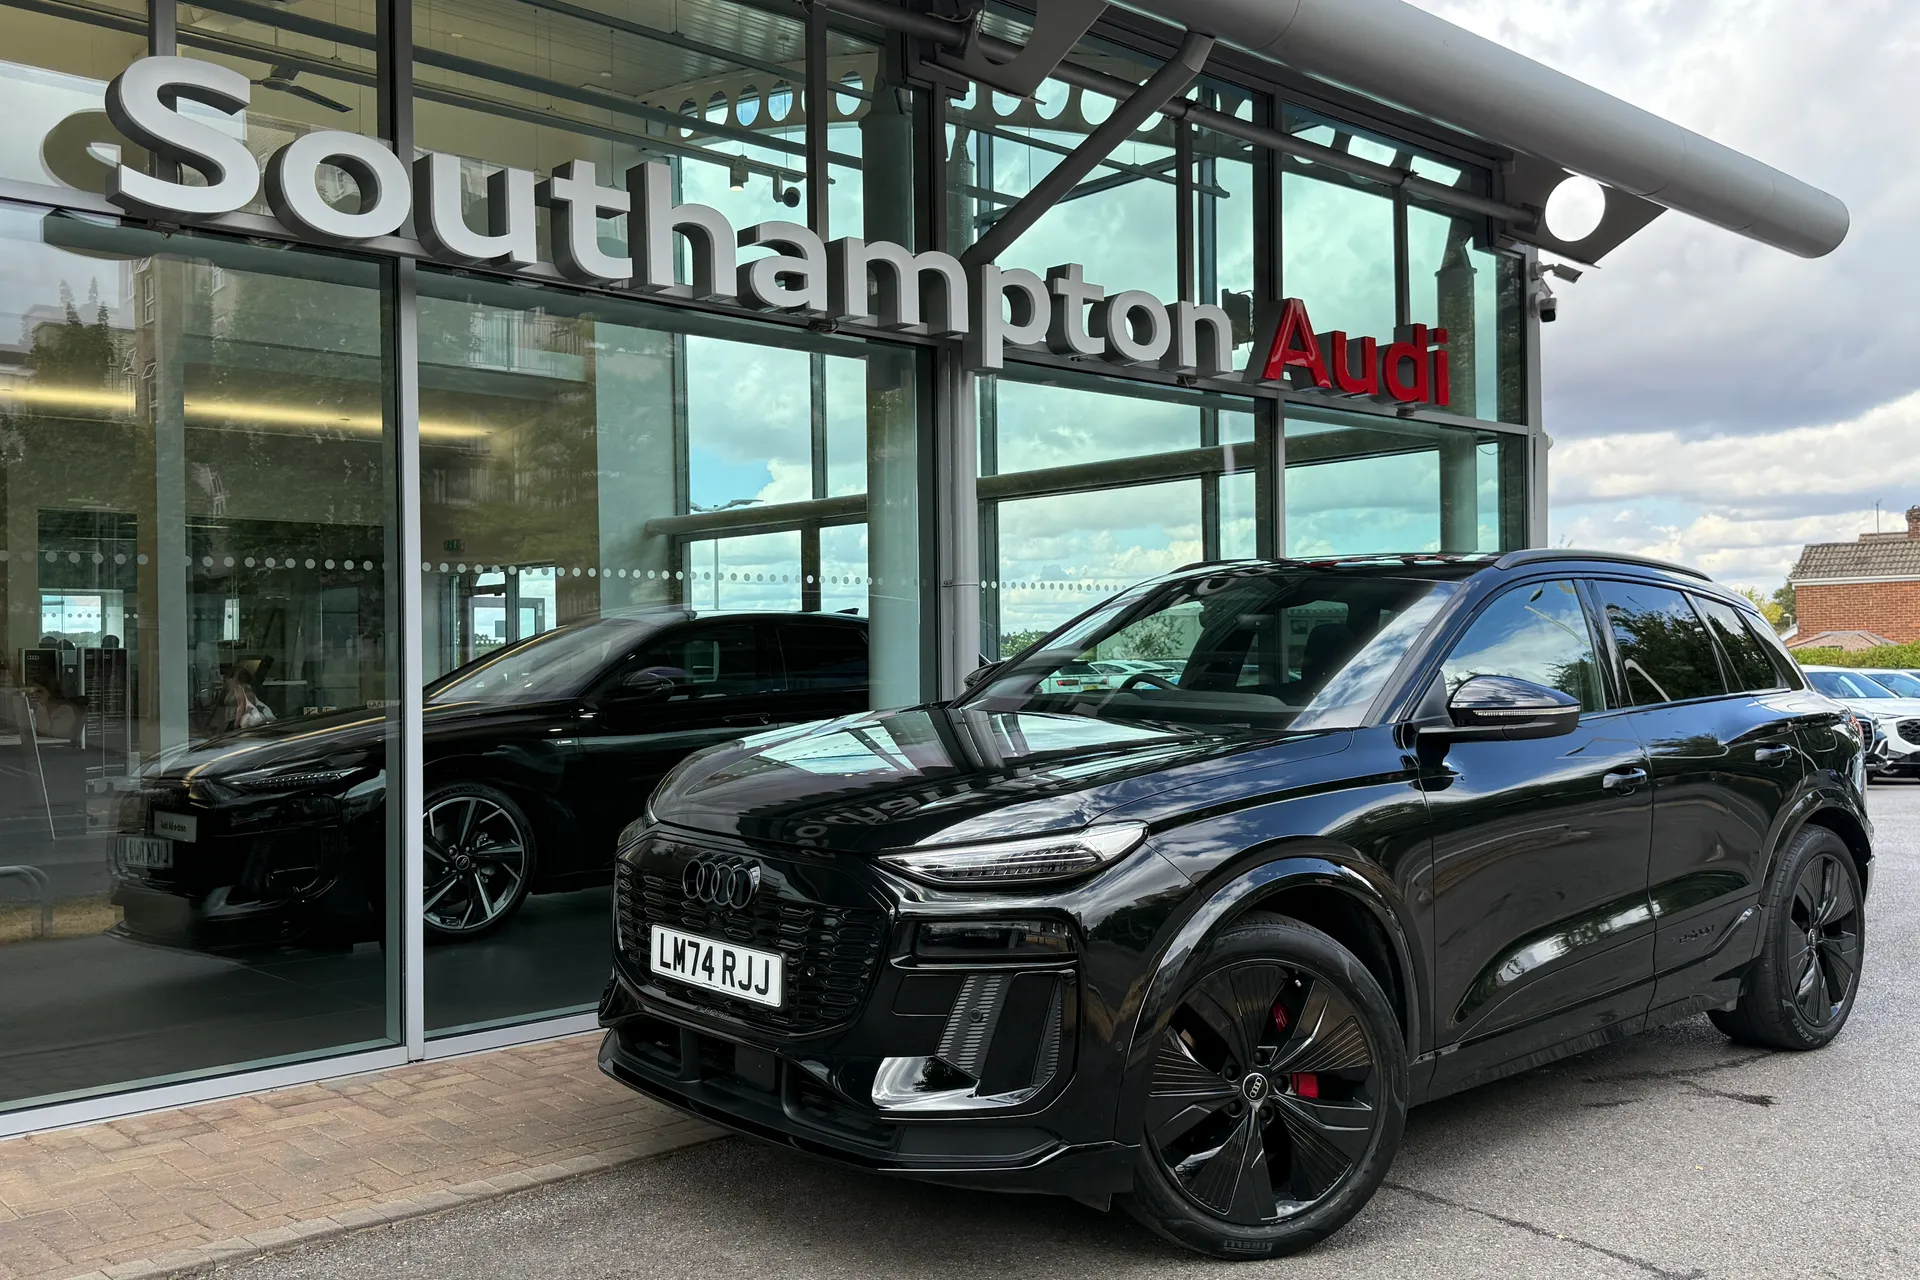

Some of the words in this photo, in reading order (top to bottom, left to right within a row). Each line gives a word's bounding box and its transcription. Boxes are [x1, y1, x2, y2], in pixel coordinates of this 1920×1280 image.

[105, 56, 1233, 372] Southampton
[1260, 297, 1450, 407] Audi
[659, 932, 715, 982] LM74
[721, 948, 770, 996] RJJ
[1791, 1018, 1814, 1043] ZERO
